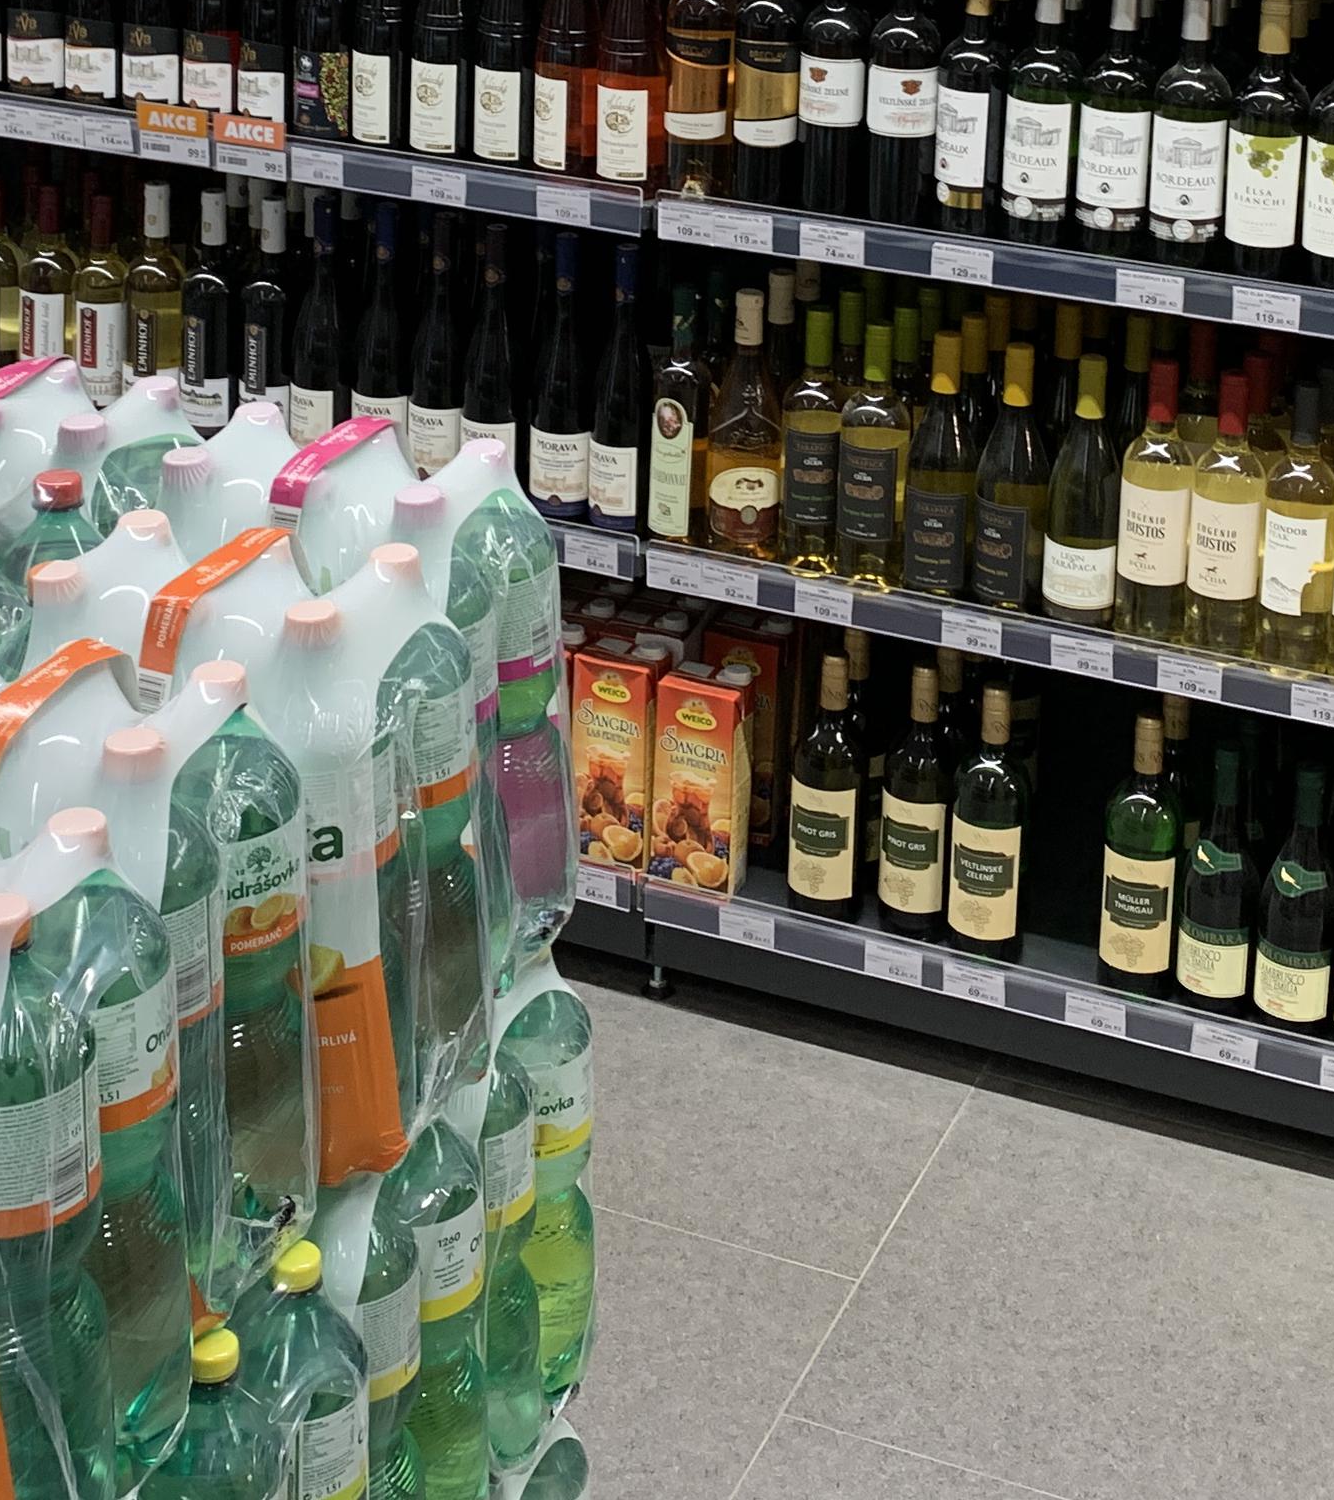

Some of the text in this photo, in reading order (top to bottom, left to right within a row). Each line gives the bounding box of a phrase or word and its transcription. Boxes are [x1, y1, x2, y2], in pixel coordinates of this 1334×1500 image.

[148, 111, 197, 132] AKCE
[224, 121, 275, 145] AKCE
[1234, 192, 1286, 208] BIANCHI
[1245, 186, 1273, 198] ELSA
[81, 318, 96, 365] EMINHOF
[137, 317, 153, 375] EMINHOF
[187, 327, 198, 383] EMINHOF
[246, 336, 257, 390] EMINHOF
[536, 438, 578, 453] MORAVA
[1126, 508, 1166, 525] EUGENIO
[1126, 521, 1165, 539] BUSTOS
[1197, 522, 1237, 538] EUGENIO
[1269, 520, 1308, 537] CONDOR
[1196, 535, 1236, 553] BUSTOS
[597, 686, 627, 700] WEICO
[576, 699, 641, 739] SANGRIA
[681, 710, 713, 726] WEICO
[660, 725, 728, 766] SANGRIA
[797, 822, 837, 839] PINOT GRIS
[887, 835, 926, 852] PINOT GRIS
[1117, 890, 1151, 906] MÜLLER
[1114, 899, 1154, 916] THURGAU
